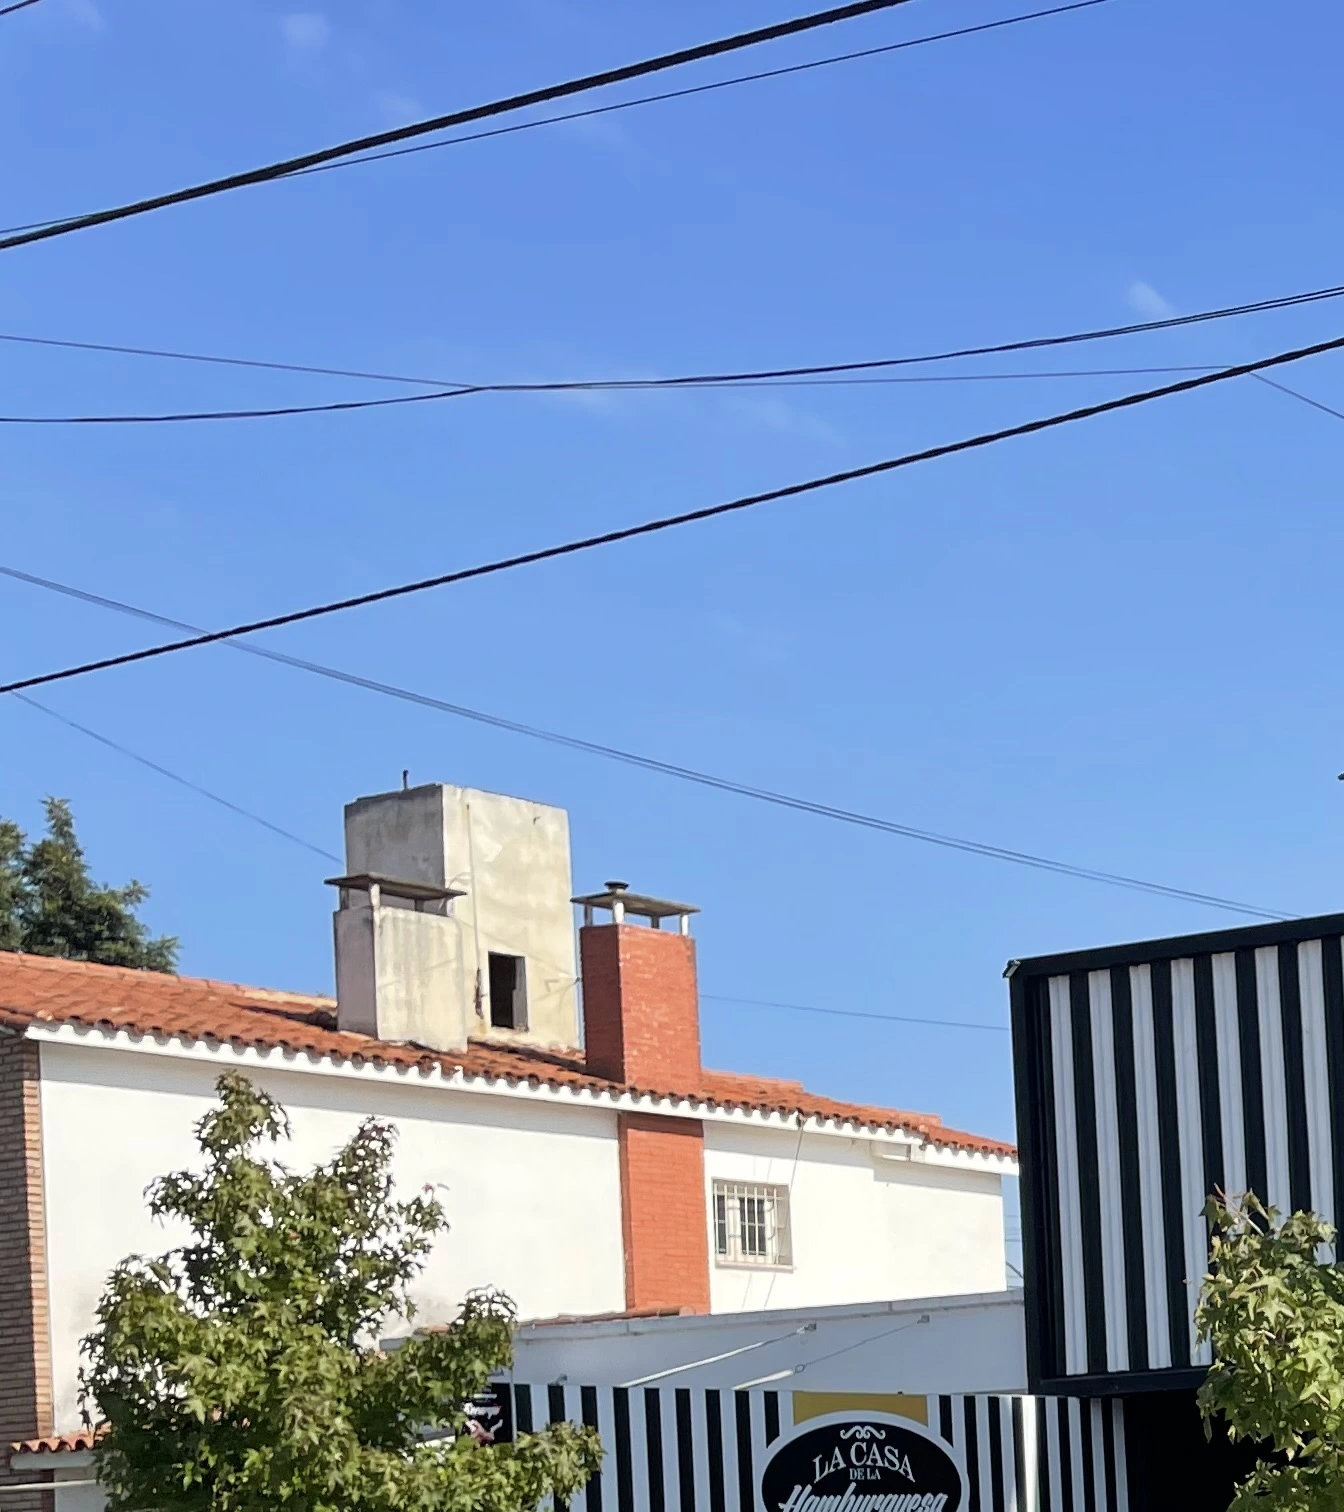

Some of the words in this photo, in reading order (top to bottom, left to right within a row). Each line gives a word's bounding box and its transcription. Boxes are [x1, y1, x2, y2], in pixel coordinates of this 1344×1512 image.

[813, 1446, 847, 1483] LA
[850, 1441, 915, 1483] CASA
[850, 1468, 864, 1480] DE
[867, 1468, 881, 1480] LA
